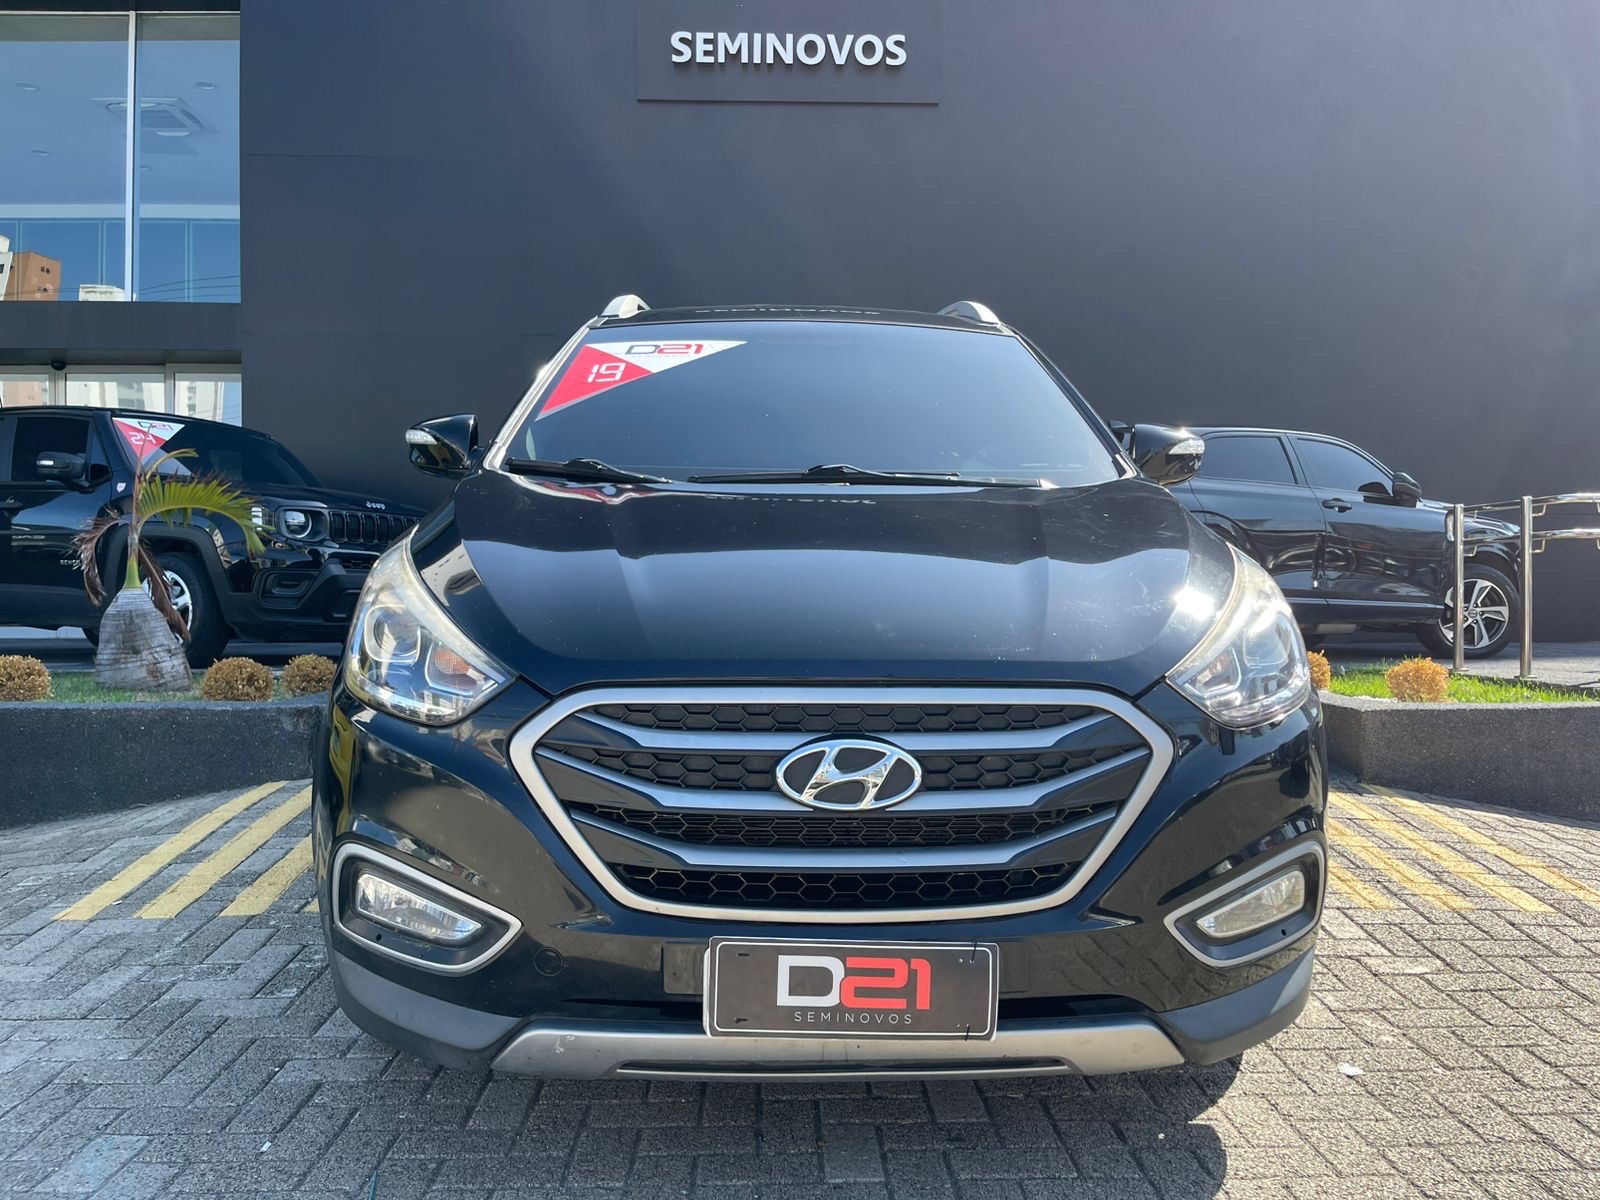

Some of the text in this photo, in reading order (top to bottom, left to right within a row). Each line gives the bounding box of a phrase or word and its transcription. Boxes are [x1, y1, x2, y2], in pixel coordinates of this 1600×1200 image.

[670, 31, 908, 66] SEMINOVOS
[625, 343, 704, 355] D21
[587, 362, 626, 383] 19
[776, 954, 932, 1010] D21
[794, 1011, 912, 1025] SEMINOVOS
